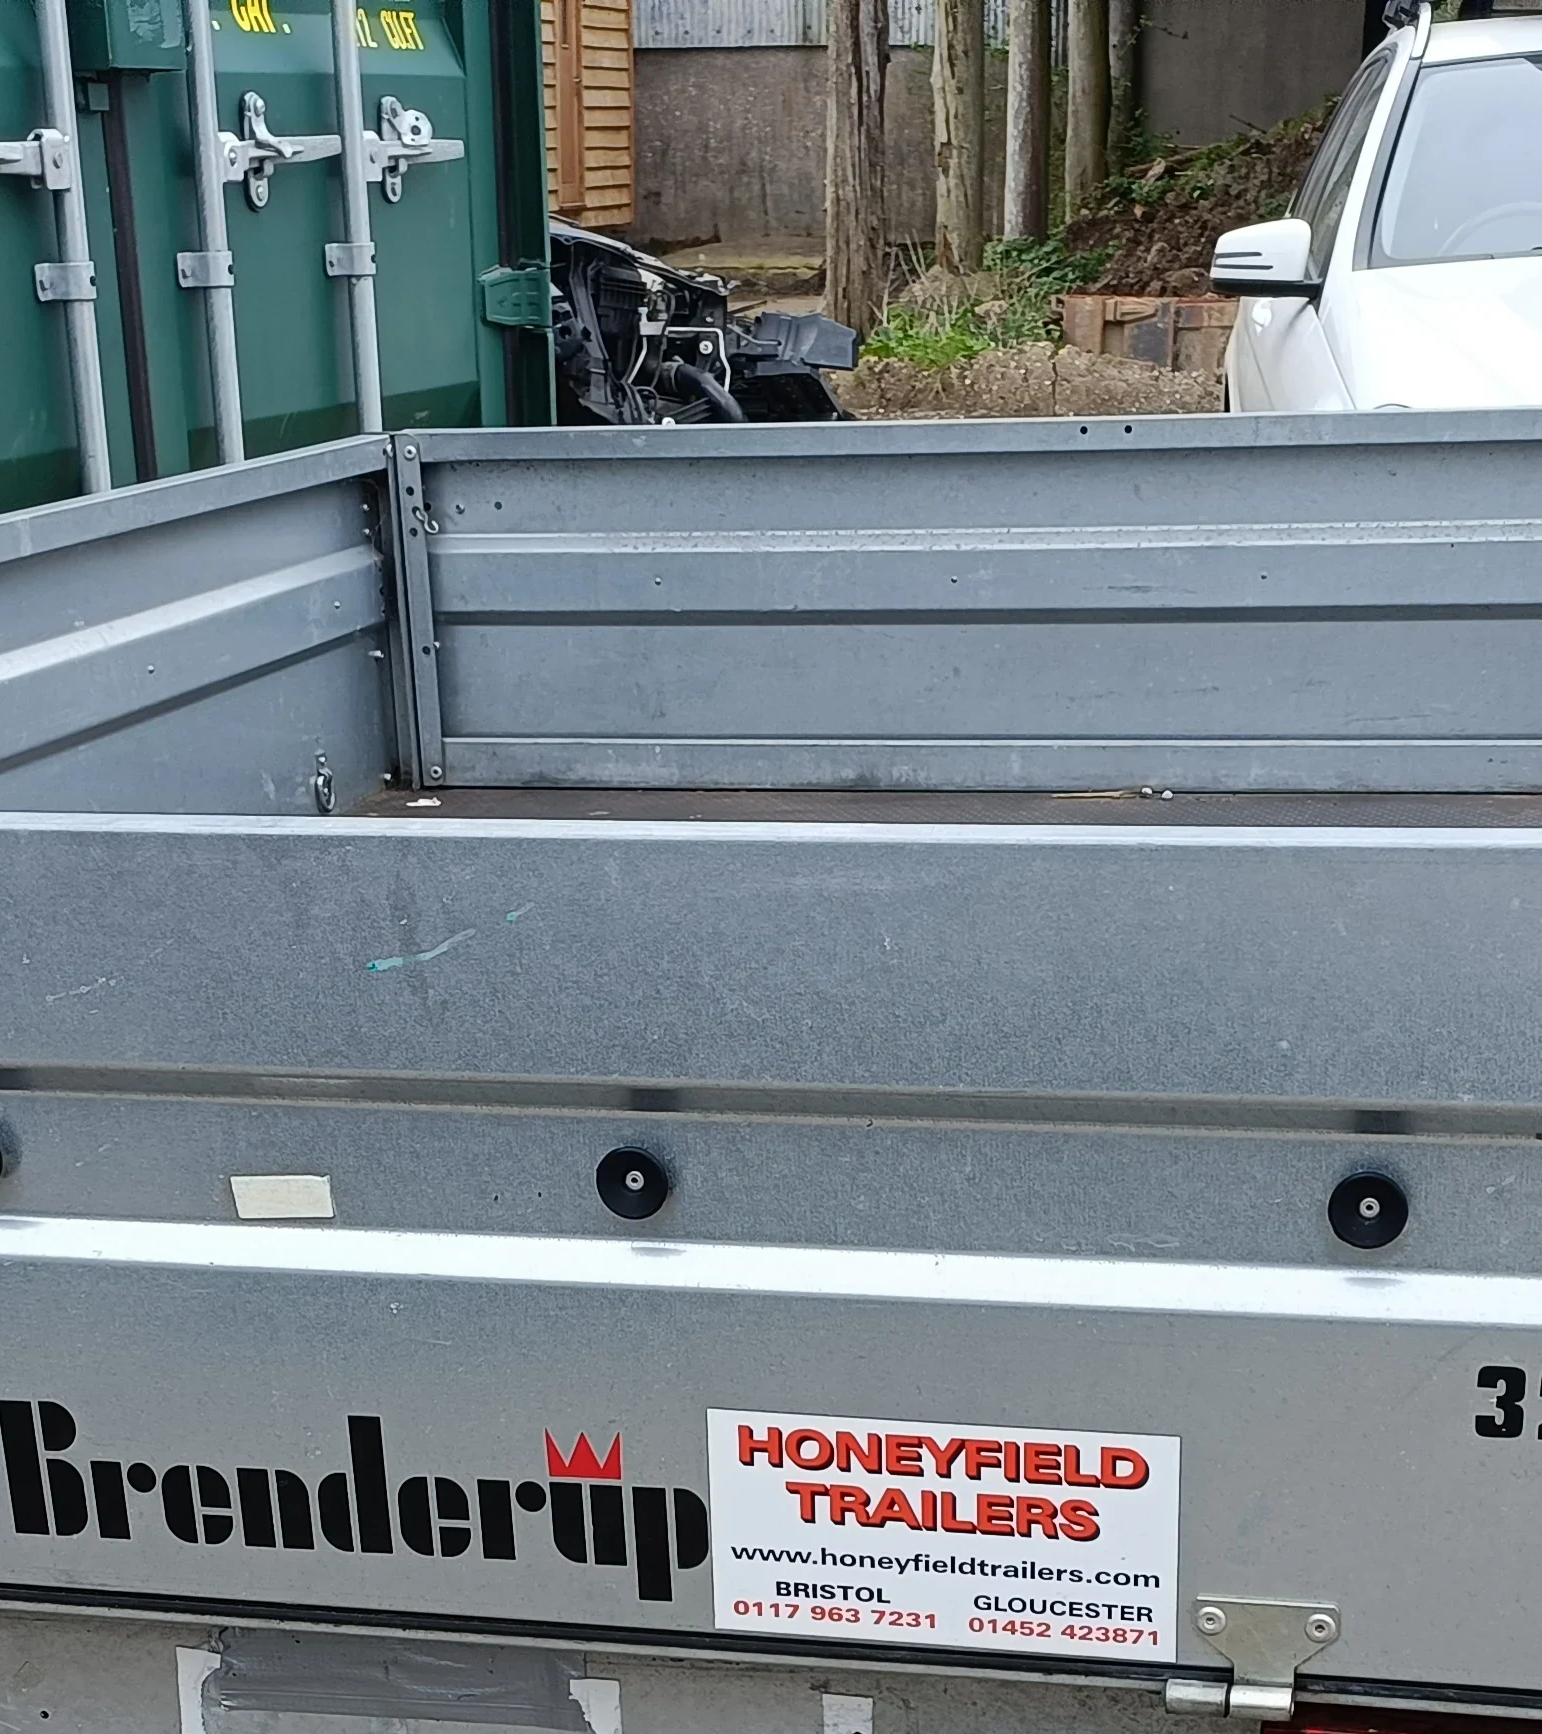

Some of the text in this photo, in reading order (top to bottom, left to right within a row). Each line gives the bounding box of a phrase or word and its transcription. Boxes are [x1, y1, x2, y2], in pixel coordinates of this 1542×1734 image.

[737, 1424, 1150, 1490] HONEYFIELD
[785, 1481, 1101, 1542] TRAILERS
[731, 1545, 1161, 1589] www.honeyfieldtrailers.com
[775, 1580, 891, 1605] BRISTOL
[733, 1599, 937, 1630] 0117 963 7231
[973, 1594, 1154, 1623] GLOUCESTER
[968, 1617, 1160, 1647] 01452 423871
